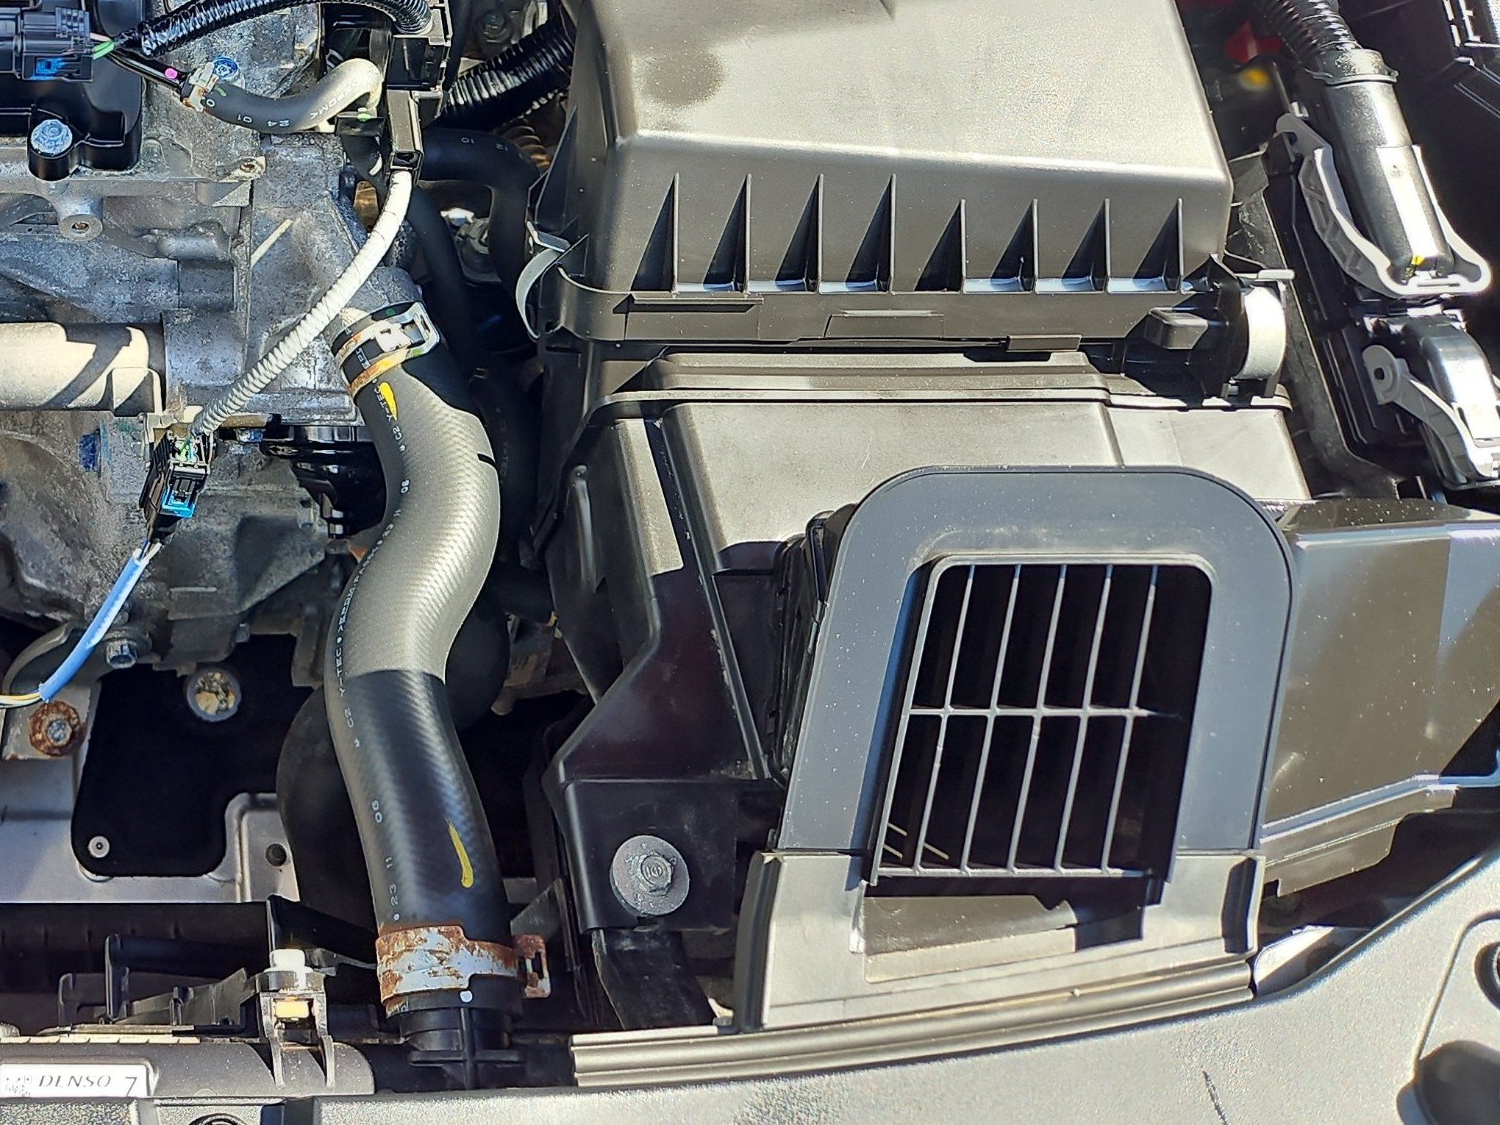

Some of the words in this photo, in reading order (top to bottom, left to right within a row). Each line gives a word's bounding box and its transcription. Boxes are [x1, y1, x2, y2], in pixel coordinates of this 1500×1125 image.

[237, 113, 253, 123] 01
[267, 118, 290, 128] 24
[336, 647, 346, 697] Y-TEC
[344, 707, 355, 729] C2
[385, 855, 395, 868] 11
[387, 884, 399, 905] 23
[39, 1075, 112, 1088] DENSO
